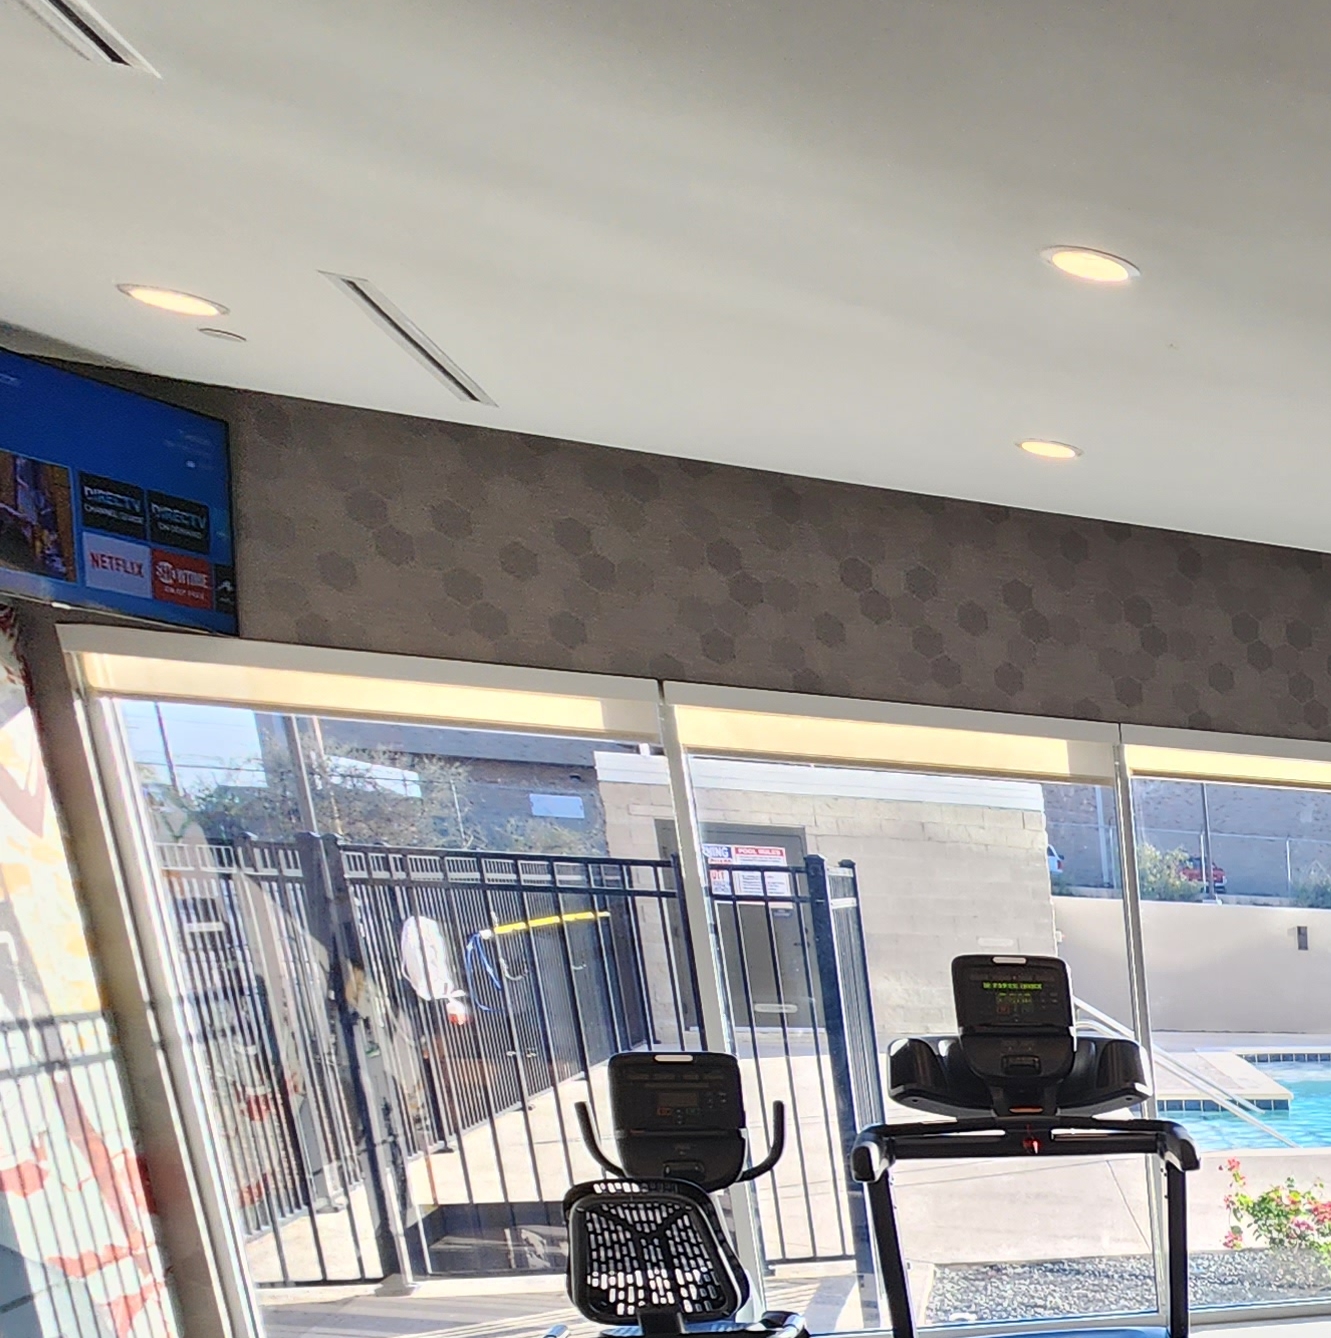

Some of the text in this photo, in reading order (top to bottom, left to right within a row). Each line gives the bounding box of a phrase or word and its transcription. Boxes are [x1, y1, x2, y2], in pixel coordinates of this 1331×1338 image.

[83, 485, 141, 512] DIRECTV
[151, 502, 206, 529] DIRECTV
[90, 552, 144, 577] NETFLIX
[155, 560, 209, 589] SHOWTIME
